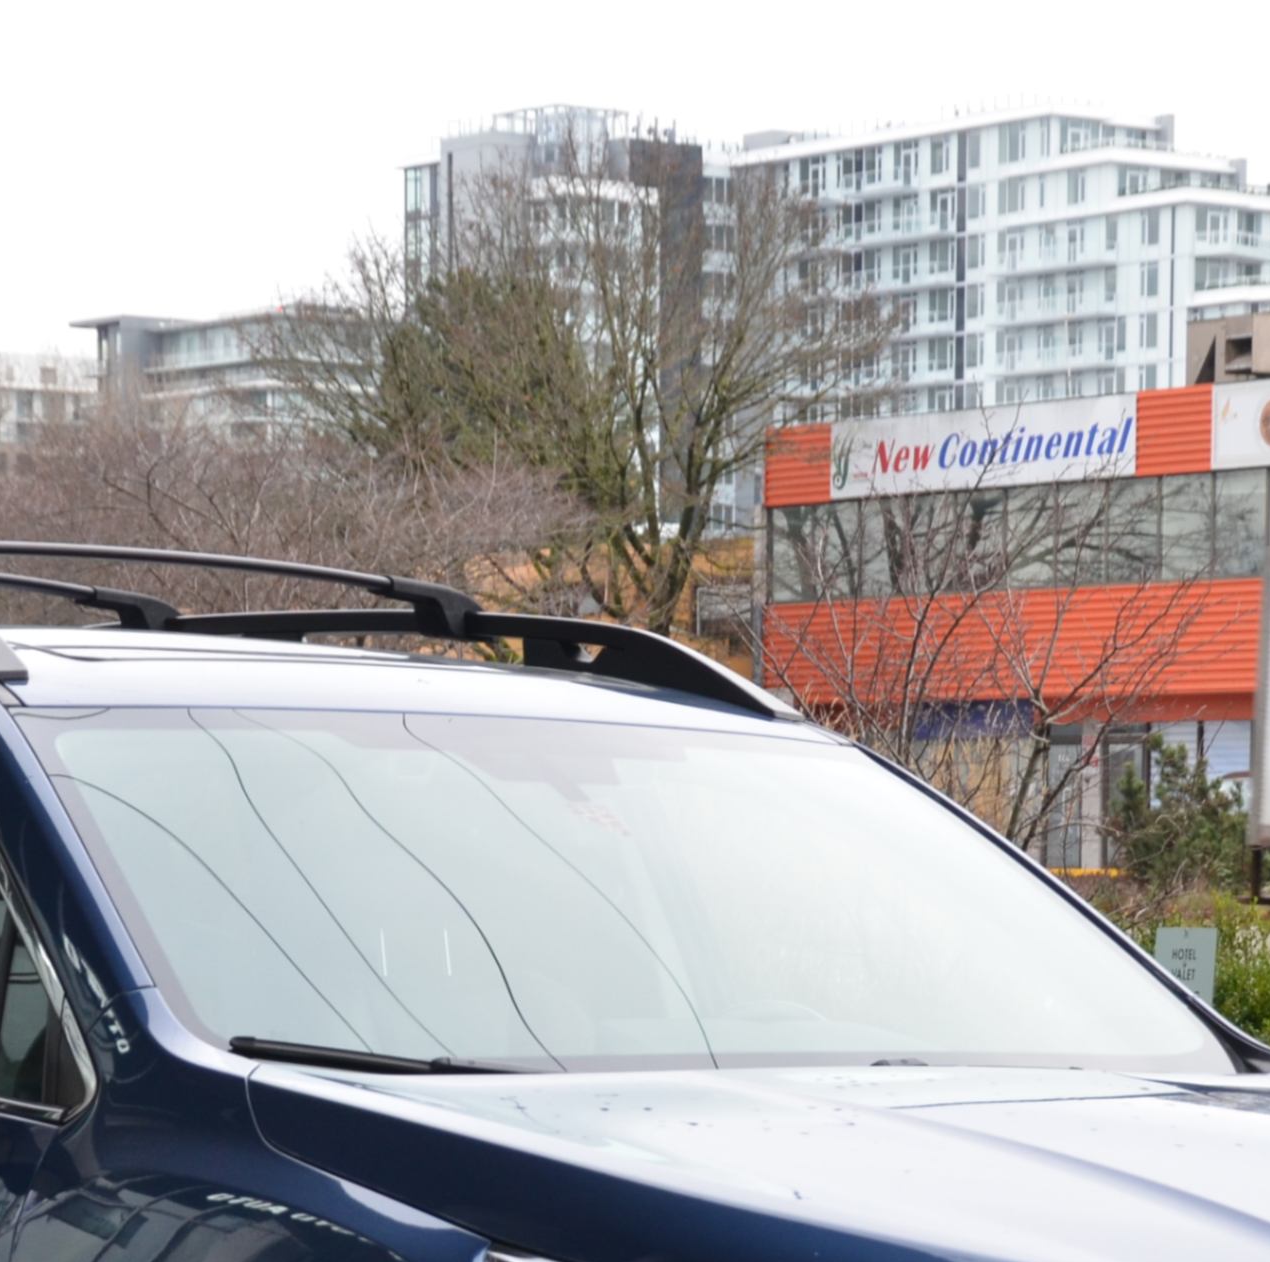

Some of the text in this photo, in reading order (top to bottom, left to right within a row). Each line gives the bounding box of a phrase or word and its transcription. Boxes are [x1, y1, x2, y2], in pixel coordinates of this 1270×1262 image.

[874, 416, 1134, 475] New Continental
[1171, 948, 1197, 961] HOTEL
